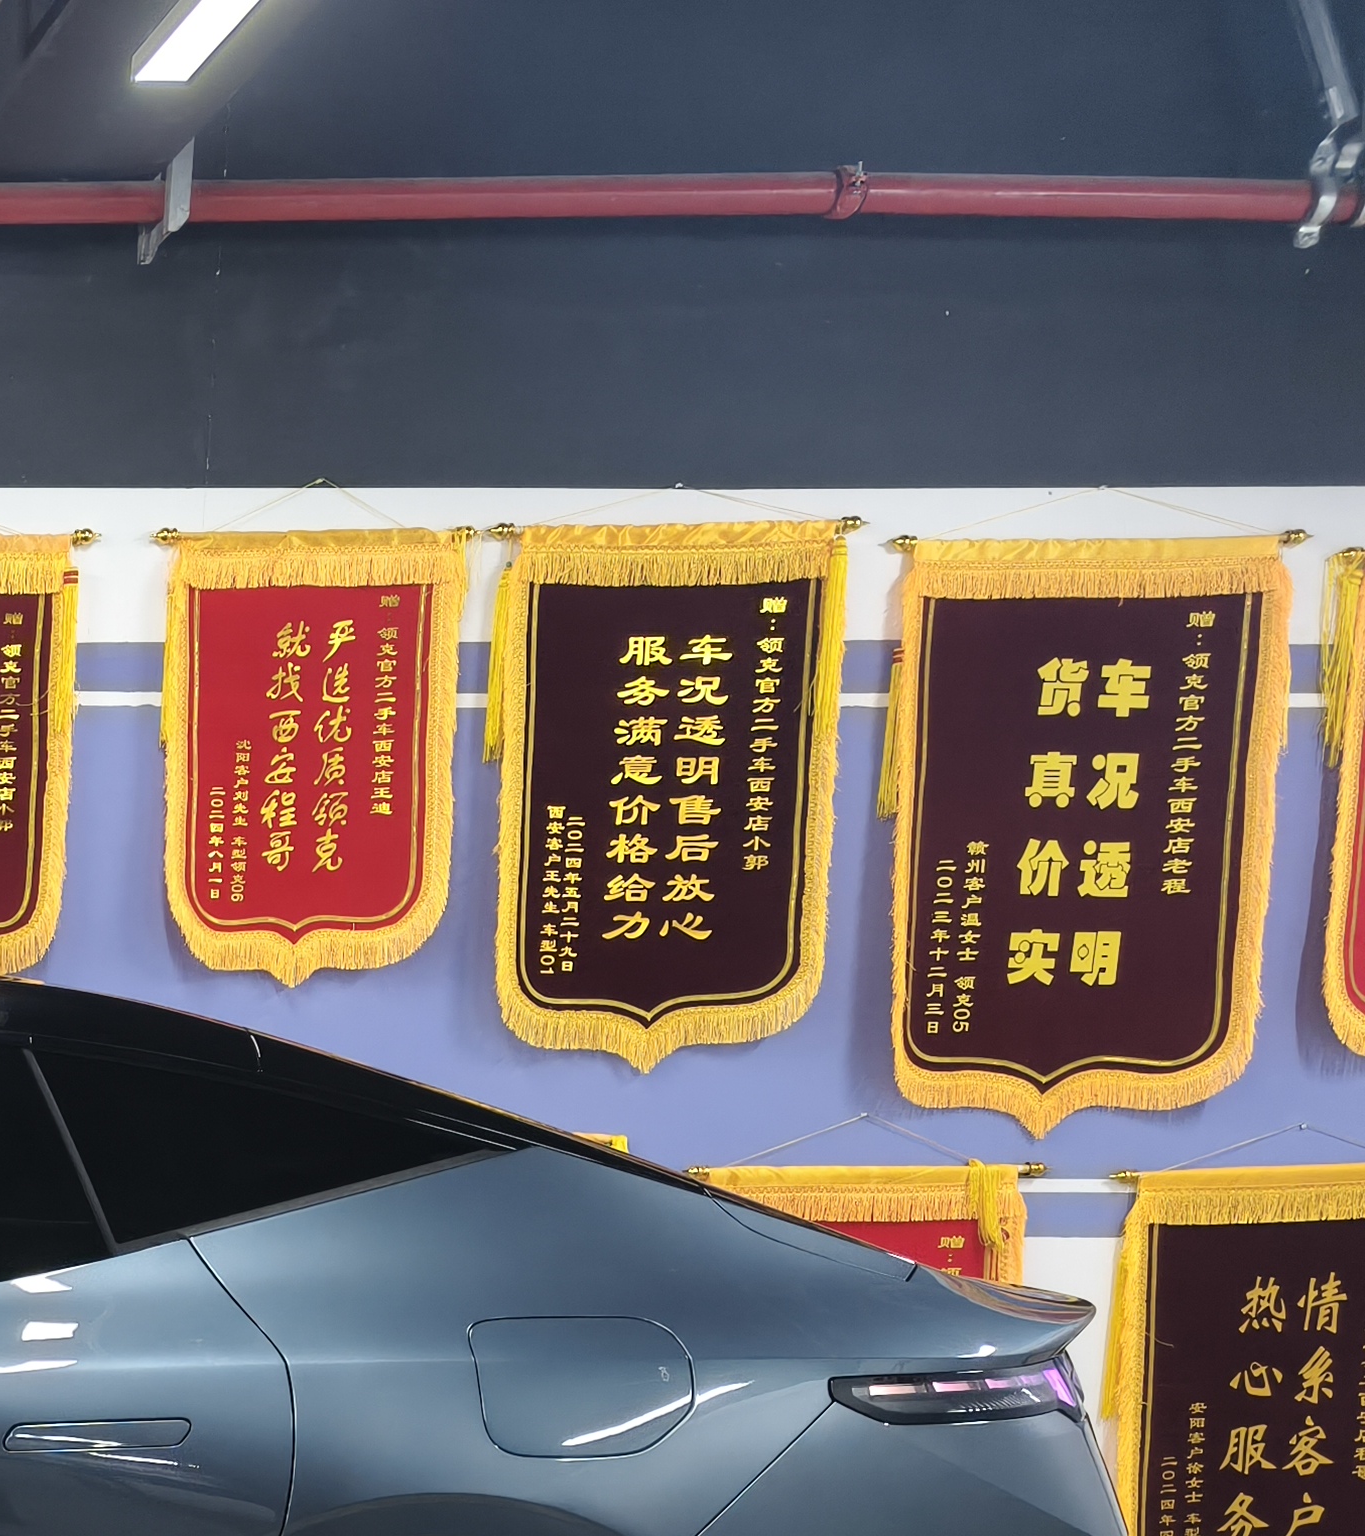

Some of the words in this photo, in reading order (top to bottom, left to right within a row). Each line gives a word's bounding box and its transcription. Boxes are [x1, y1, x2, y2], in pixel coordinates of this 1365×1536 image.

[259, 620, 312, 872] 就找西安程哥
[311, 619, 357, 873] 严选优质领克
[541, 805, 567, 915] 西安客户王先生
[601, 635, 673, 940] 服务满意价格给力
[658, 634, 732, 940] 车况透明售后放心
[741, 596, 788, 871] 赠：领克官方二手车西安店小郭
[1006, 656, 1090, 987] 货真价实
[1070, 658, 1152, 987] 车况透明
[1160, 611, 1215, 896] 赠：领克官方二手车西安店老程
[539, 922, 559, 975] 车型01
[952, 975, 976, 1034] 领克05
